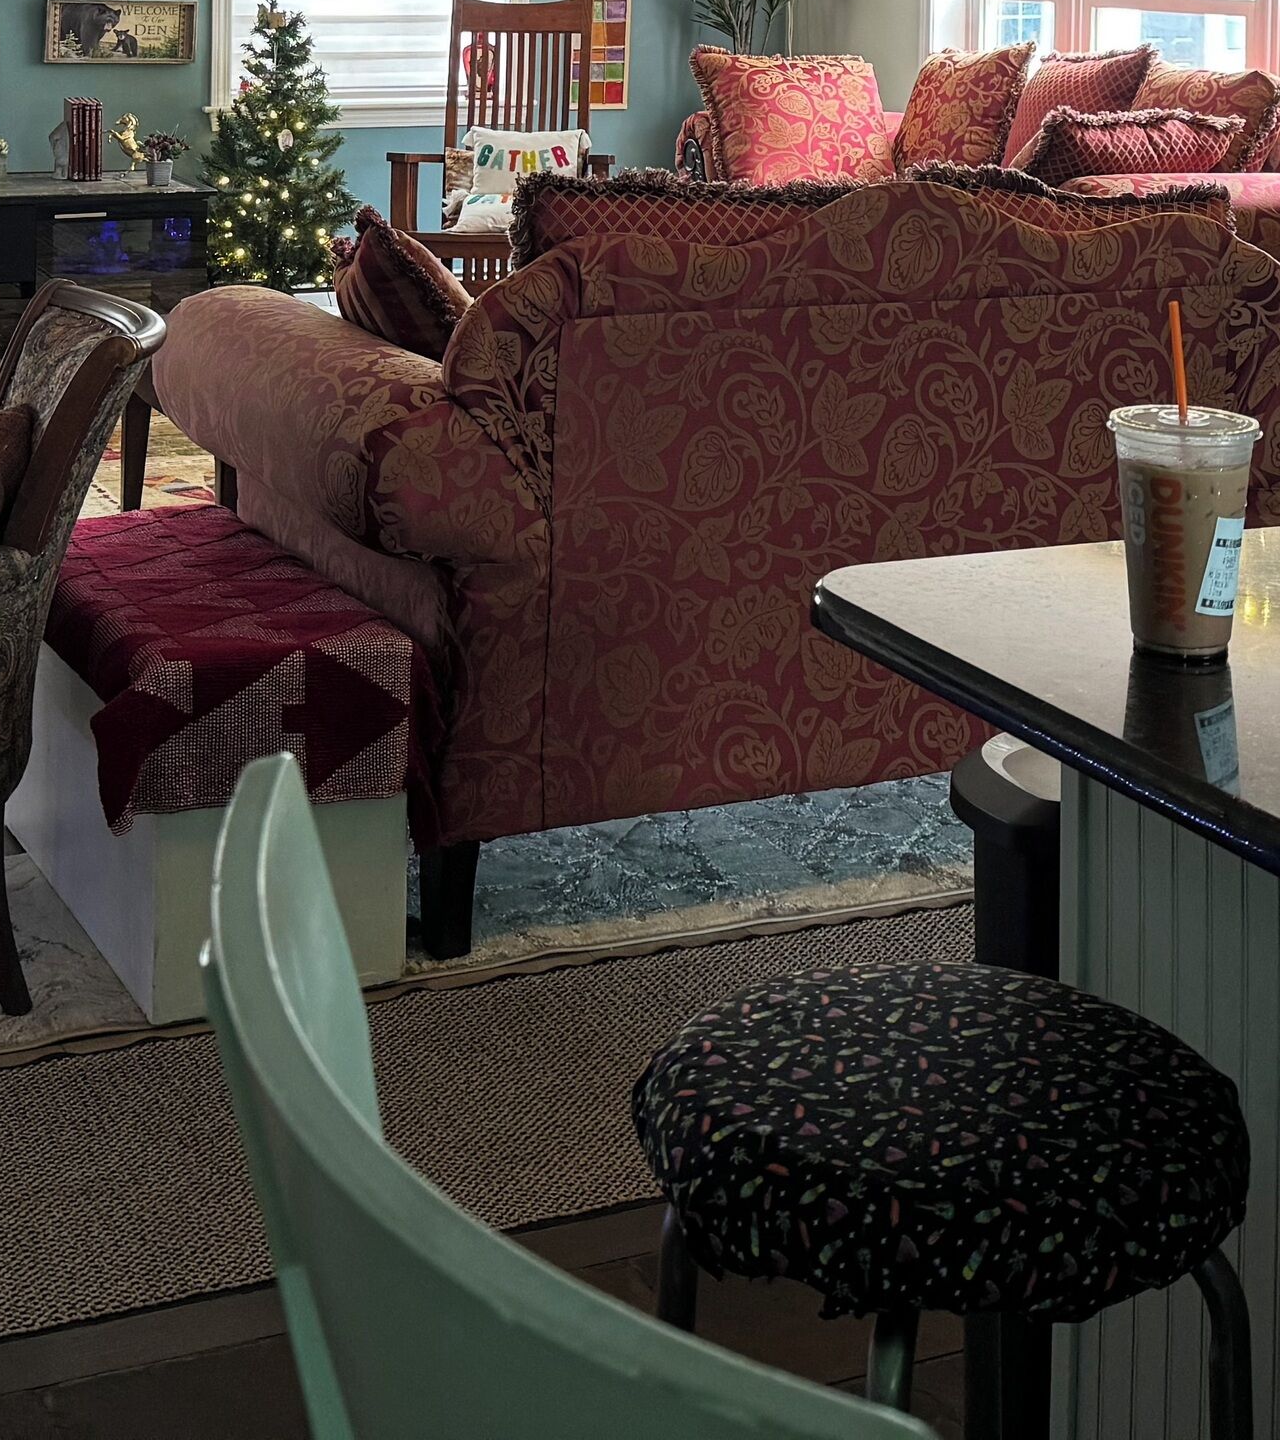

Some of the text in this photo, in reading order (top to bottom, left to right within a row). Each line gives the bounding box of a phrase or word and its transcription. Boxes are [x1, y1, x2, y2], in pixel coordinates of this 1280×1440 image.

[120, 4, 178, 16] WELCOME
[134, 23, 167, 36] DEN
[476, 144, 570, 173] GATHER
[1127, 471, 1146, 546] ICED
